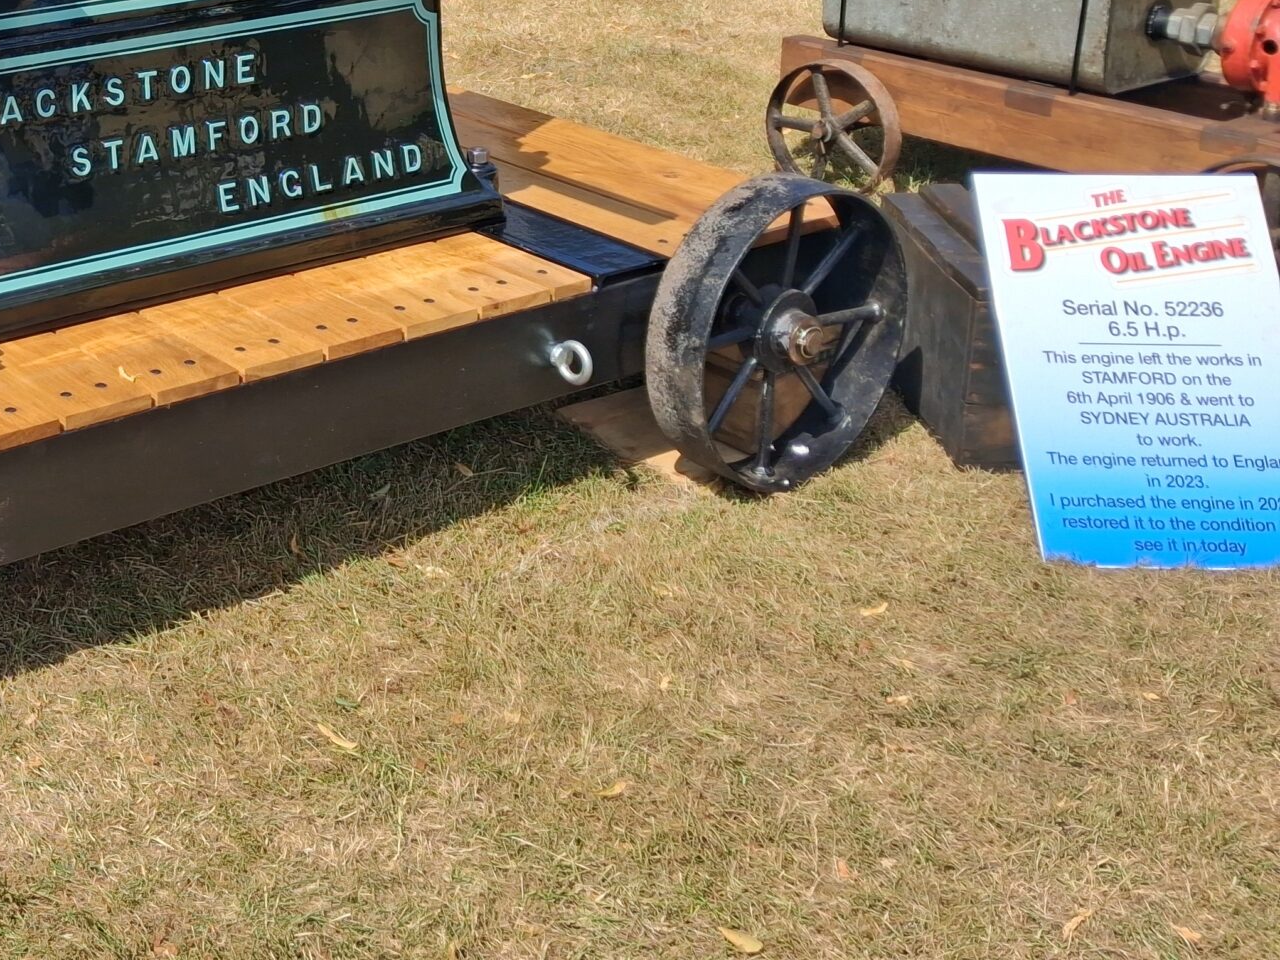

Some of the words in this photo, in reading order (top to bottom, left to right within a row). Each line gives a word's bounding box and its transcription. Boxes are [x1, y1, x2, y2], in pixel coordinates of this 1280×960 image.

[71, 103, 322, 177] STAMFORD
[219, 144, 422, 213] ENGLAND
[1091, 189, 1127, 208] THE
[1002, 208, 1195, 272] BLACKSTONE
[1100, 246, 1154, 275] OIL
[1151, 238, 1253, 268] ENGINE
[1062, 299, 1117, 317] Serial
[1124, 300, 1159, 317] No.
[1164, 300, 1224, 318] 52236
[1108, 321, 1139, 337] 6.5
[1145, 322, 1186, 341] H.p.
[1042, 350, 1077, 364] This
[1081, 352, 1134, 368] engine
[1138, 352, 1163, 366] left
[1166, 353, 1192, 366] the
[1196, 353, 1244, 366] works
[1247, 353, 1262, 366] in
[1082, 371, 1177, 385] STAMFORD
[1182, 375, 1202, 386] on
[1206, 374, 1232, 386] the
[1066, 391, 1092, 404] 6th
[1096, 392, 1133, 408] April
[1138, 392, 1176, 406] 1906
[1180, 393, 1192, 406] &
[1196, 394, 1235, 406] went
[1238, 394, 1255, 406] to
[1080, 411, 1150, 426] SYDNEY
[1154, 412, 1252, 427] AUSTRALIA
[1136, 434, 1154, 446] to
[1158, 434, 1202, 447] work.
[1046, 451, 1078, 465] The
[1082, 452, 1136, 469] engine
[1141, 454, 1208, 468] returned
[1212, 455, 1229, 468] to
[1233, 454, 1280, 472] Engla
[1146, 474, 1161, 488] in
[1165, 474, 1210, 488] 2023.
[1050, 492, 1056, 506] I
[1060, 494, 1146, 510] purchased
[1150, 495, 1176, 509] the
[1181, 496, 1236, 513] engine
[1239, 496, 1254, 511] in
[1062, 515, 1130, 530] restored
[1134, 516, 1145, 530] it
[1148, 517, 1166, 530] to
[1170, 518, 1196, 531] the
[1200, 518, 1276, 532] condition
[1134, 540, 1164, 552] see
[1168, 538, 1178, 552] it
[1182, 538, 1198, 552] in
[1201, 538, 1247, 556] today
